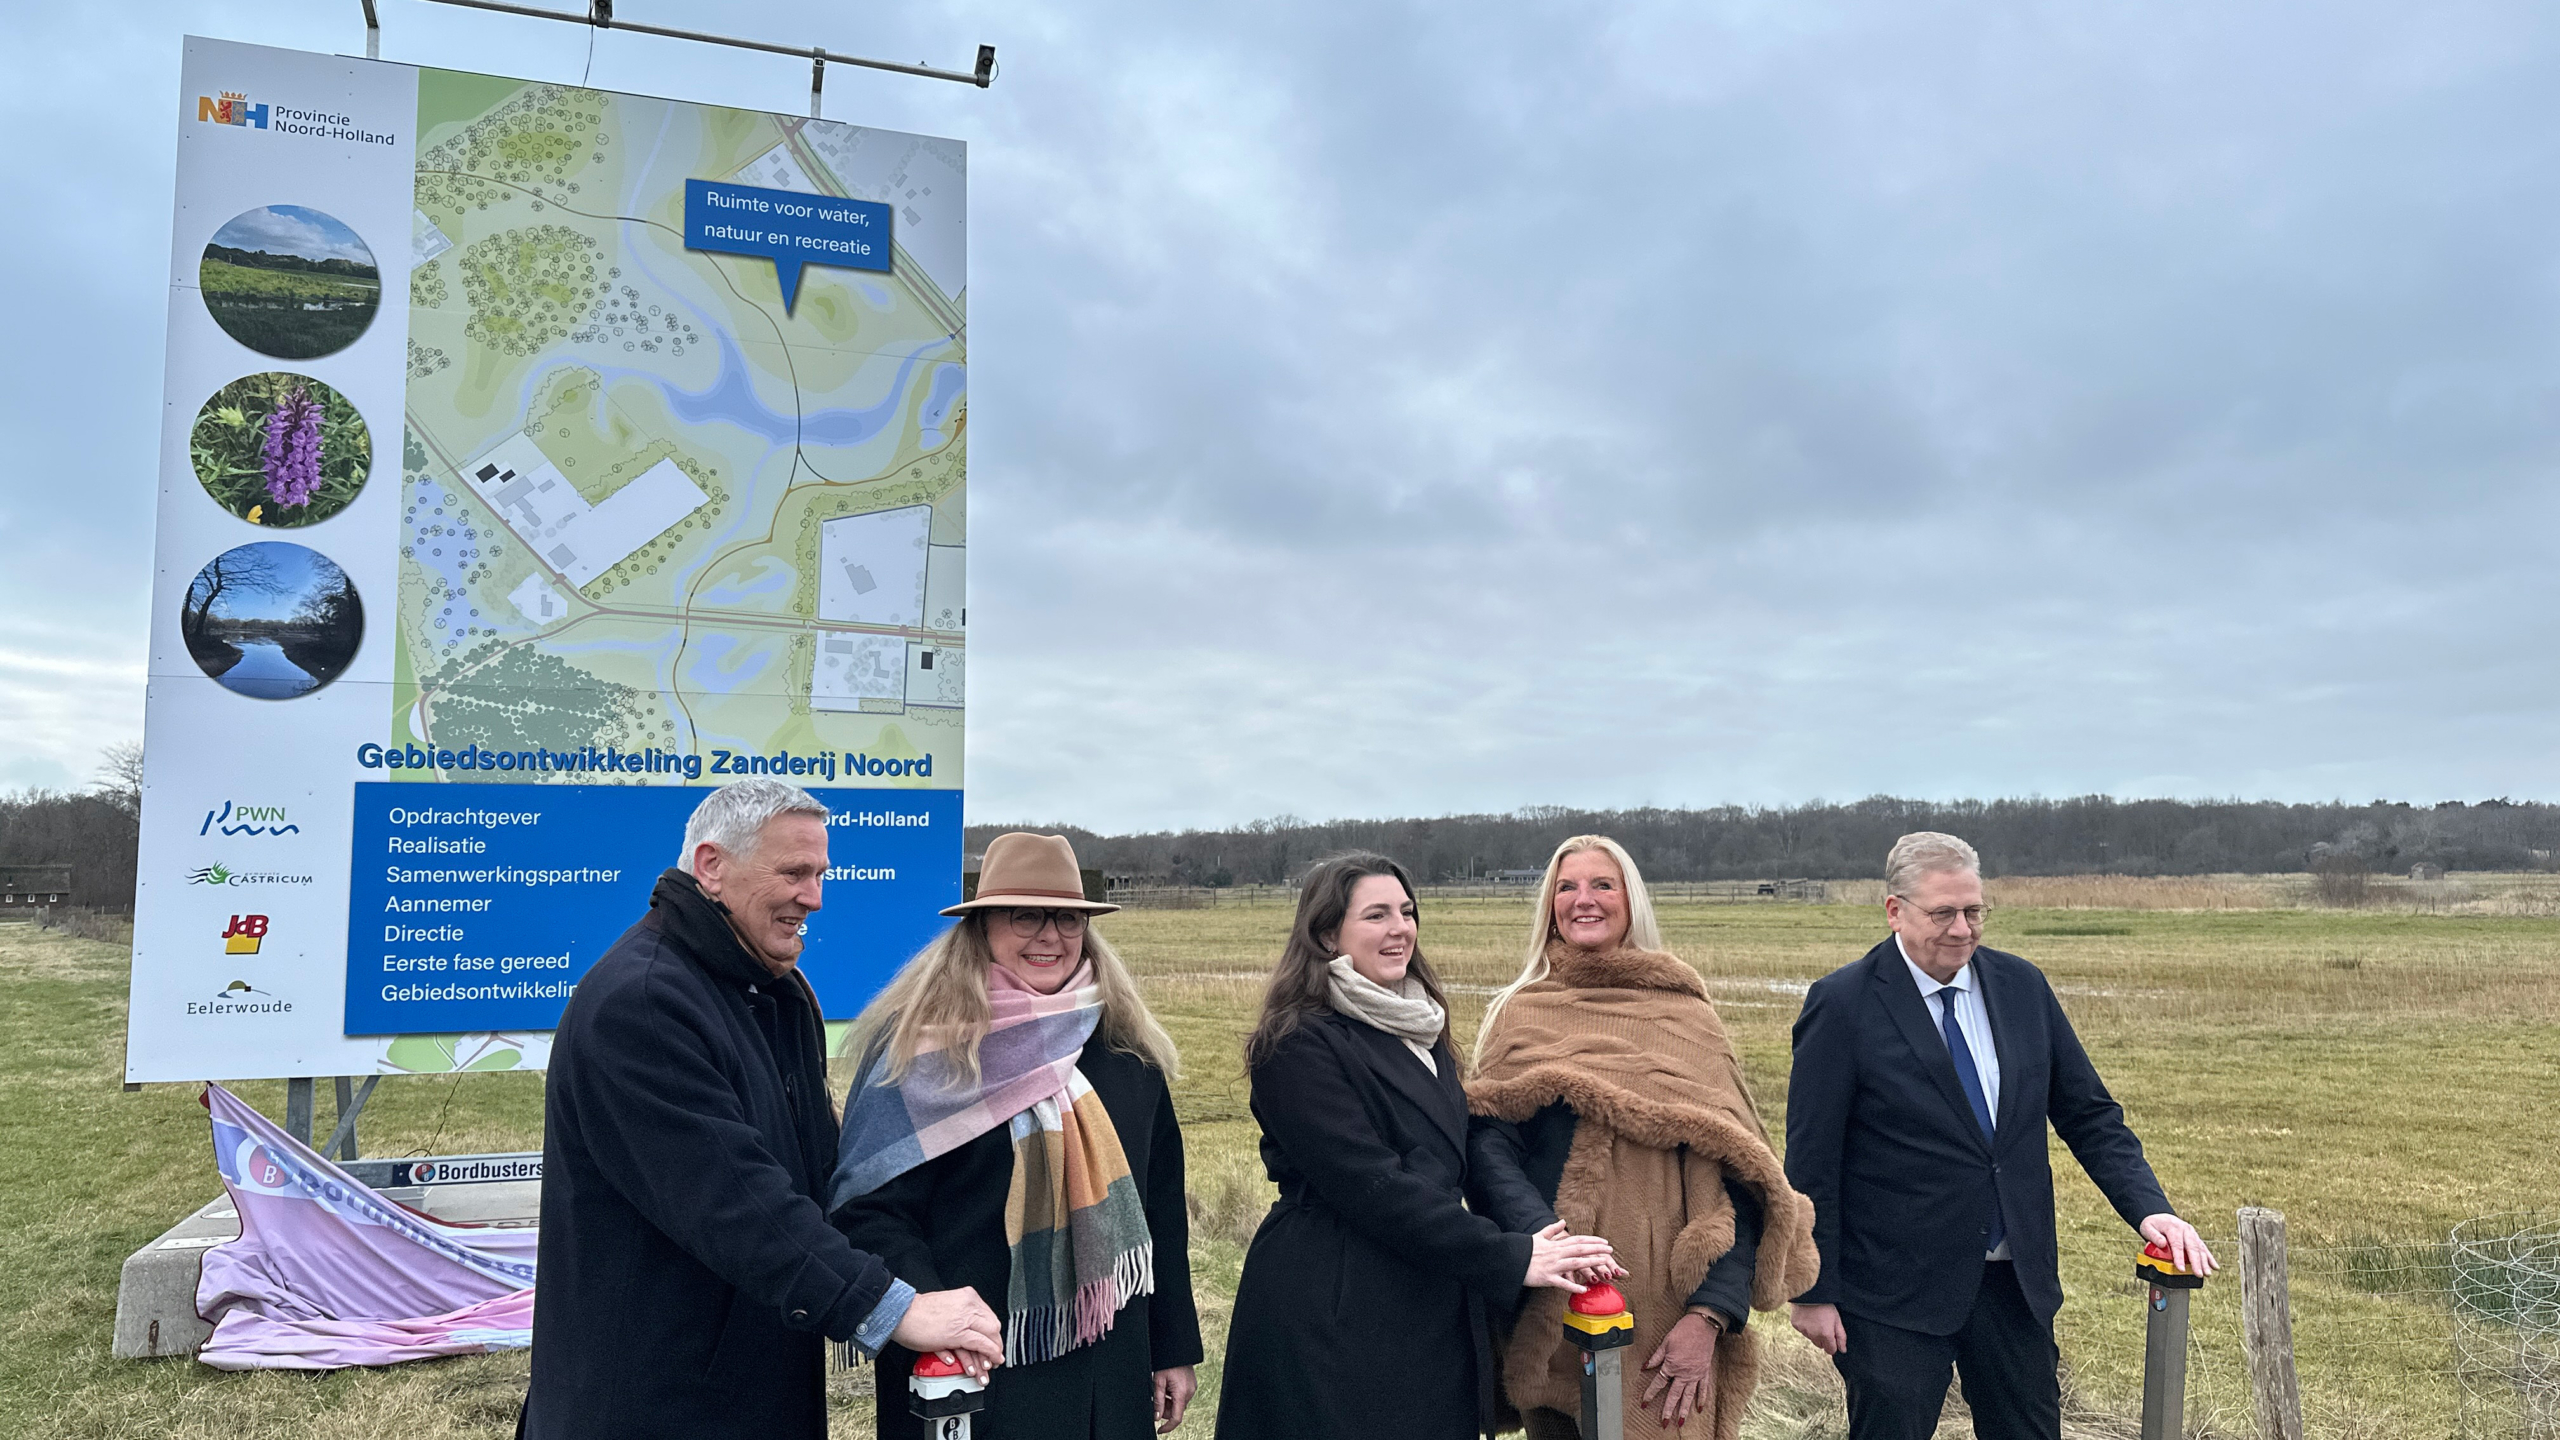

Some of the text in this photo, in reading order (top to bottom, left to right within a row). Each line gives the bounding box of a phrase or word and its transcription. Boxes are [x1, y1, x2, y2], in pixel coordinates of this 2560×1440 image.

[276, 106, 350, 126] Provincie
[275, 120, 395, 146] Noord-Holland
[707, 191, 870, 228] Ruimte voor water,
[704, 224, 871, 256] natuur en recreatie
[357, 743, 932, 781] Gebiedsontwikkeling Zanderij Noord
[236, 806, 285, 822] PWN
[389, 807, 541, 829] Opdrachtgever
[823, 810, 930, 827] ord-Holland
[388, 836, 486, 854] Realisatie
[386, 866, 621, 887] Samenwerkingspartner
[822, 864, 896, 881] stricum
[384, 896, 492, 913] Aannemer
[221, 914, 270, 939] JdB
[384, 925, 464, 943] Directie
[383, 952, 570, 974] Eerste fase gereed
[381, 981, 577, 1001] Gebiedsontwikkelin
[186, 1000, 293, 1015] Eelerwoude
[263, 1165, 277, 1184] B
[438, 1161, 543, 1181] Bordbusters
